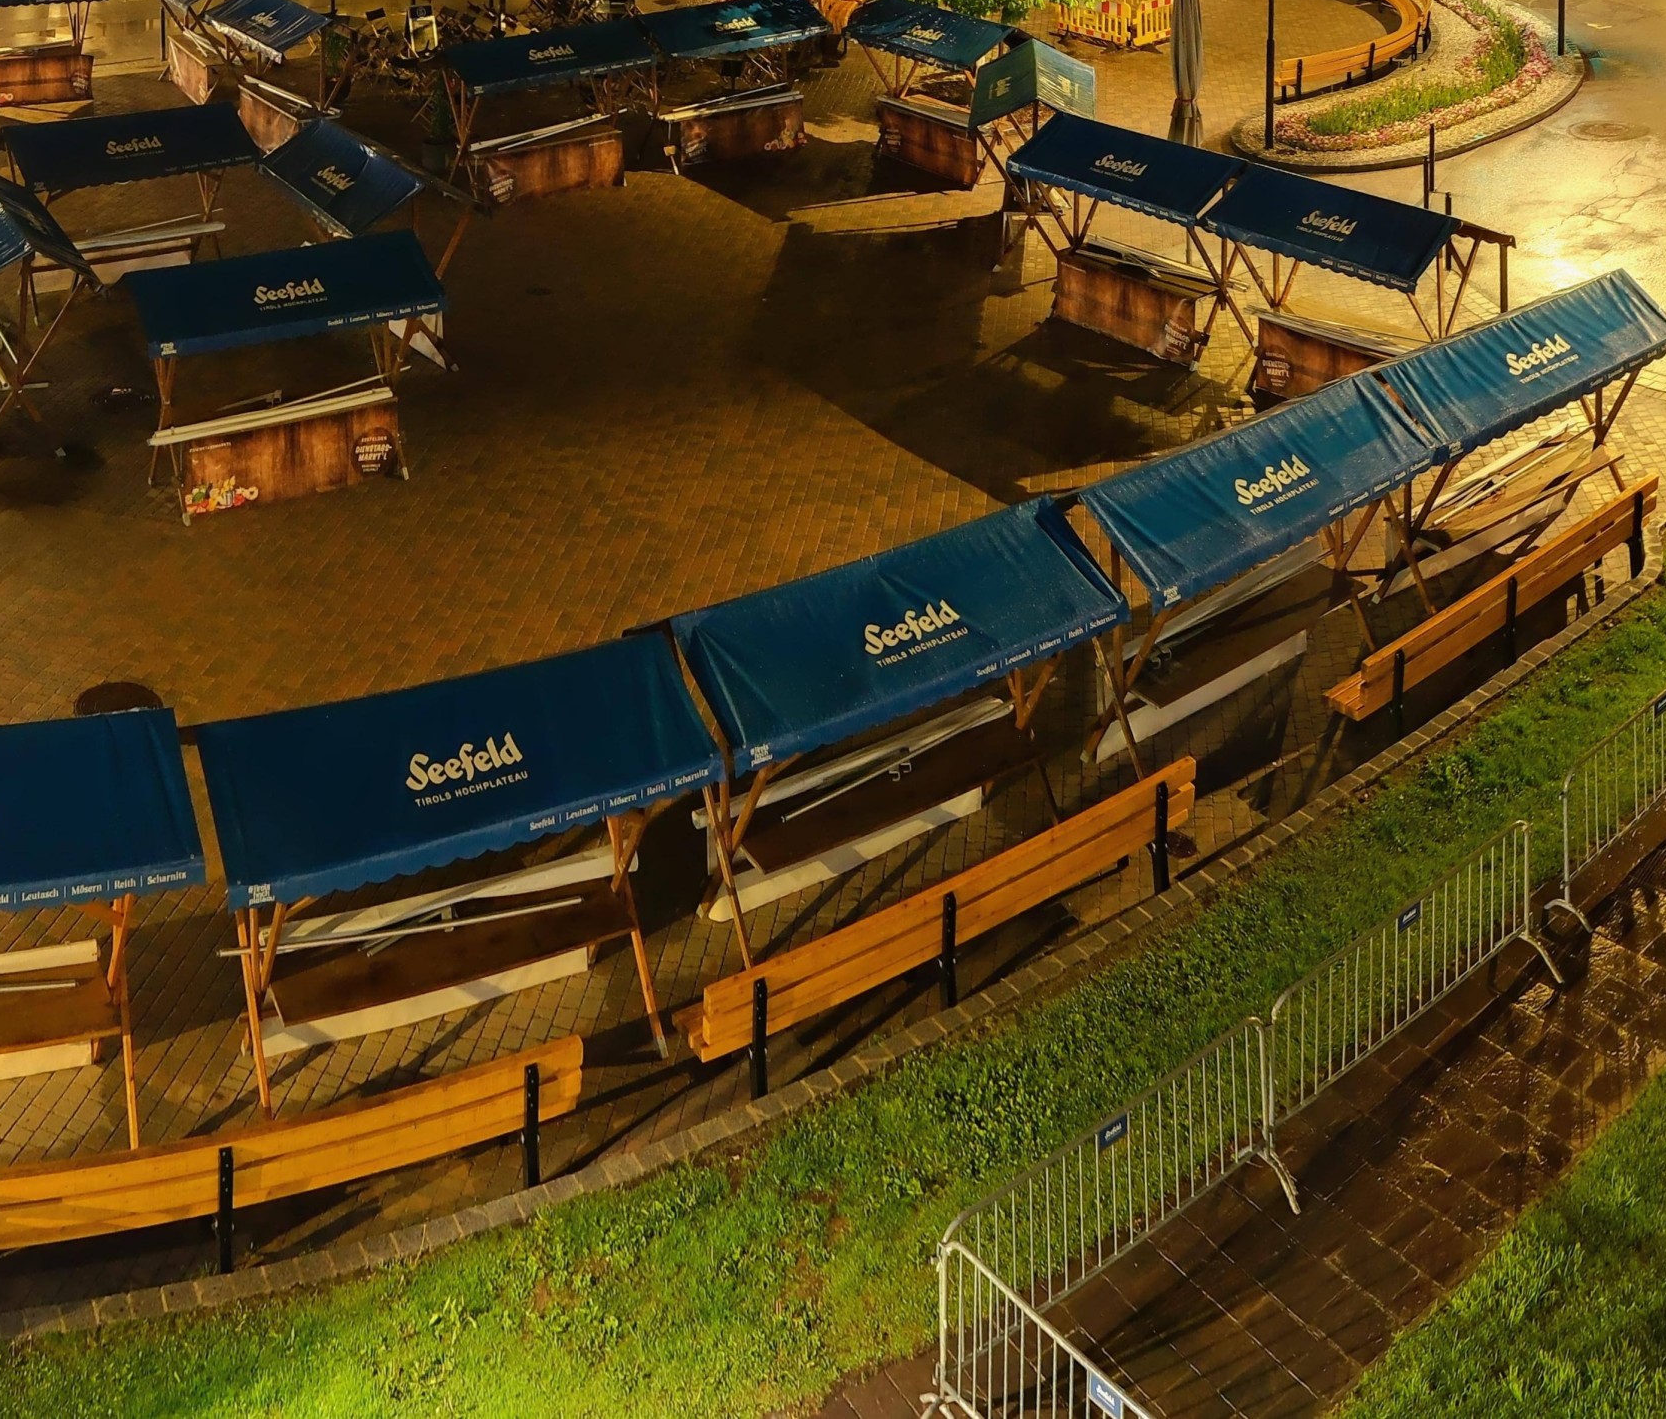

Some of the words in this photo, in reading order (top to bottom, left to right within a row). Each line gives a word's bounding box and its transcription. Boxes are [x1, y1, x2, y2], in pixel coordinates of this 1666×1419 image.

[715, 17, 757, 32] Seefeld
[529, 45, 574, 61] Seefeld
[106, 136, 162, 155] Seefeld
[1095, 154, 1148, 176] Seefeld
[1301, 210, 1358, 235] Seefeld
[253, 278, 325, 304] Seefeld
[1506, 333, 1571, 376] Seefeld
[1234, 454, 1310, 505] Seefeld
[864, 599, 960, 655] Seefeld
[876, 650, 908, 668] TIROLS
[909, 627, 969, 655] HOCHPLATEAU
[406, 732, 523, 791] Seefeld
[415, 792, 452, 808] TIROLS
[455, 770, 529, 798] HOCHPLATEAU
[529, 815, 556, 833] Seefeld
[566, 805, 599, 821] Leutasch
[647, 783, 667, 798] Reith
[674, 769, 709, 787] Scharnitz
[21, 888, 59, 901] Leutasch
[114, 877, 136, 891] Reith
[146, 871, 187, 885] Scharnitz
